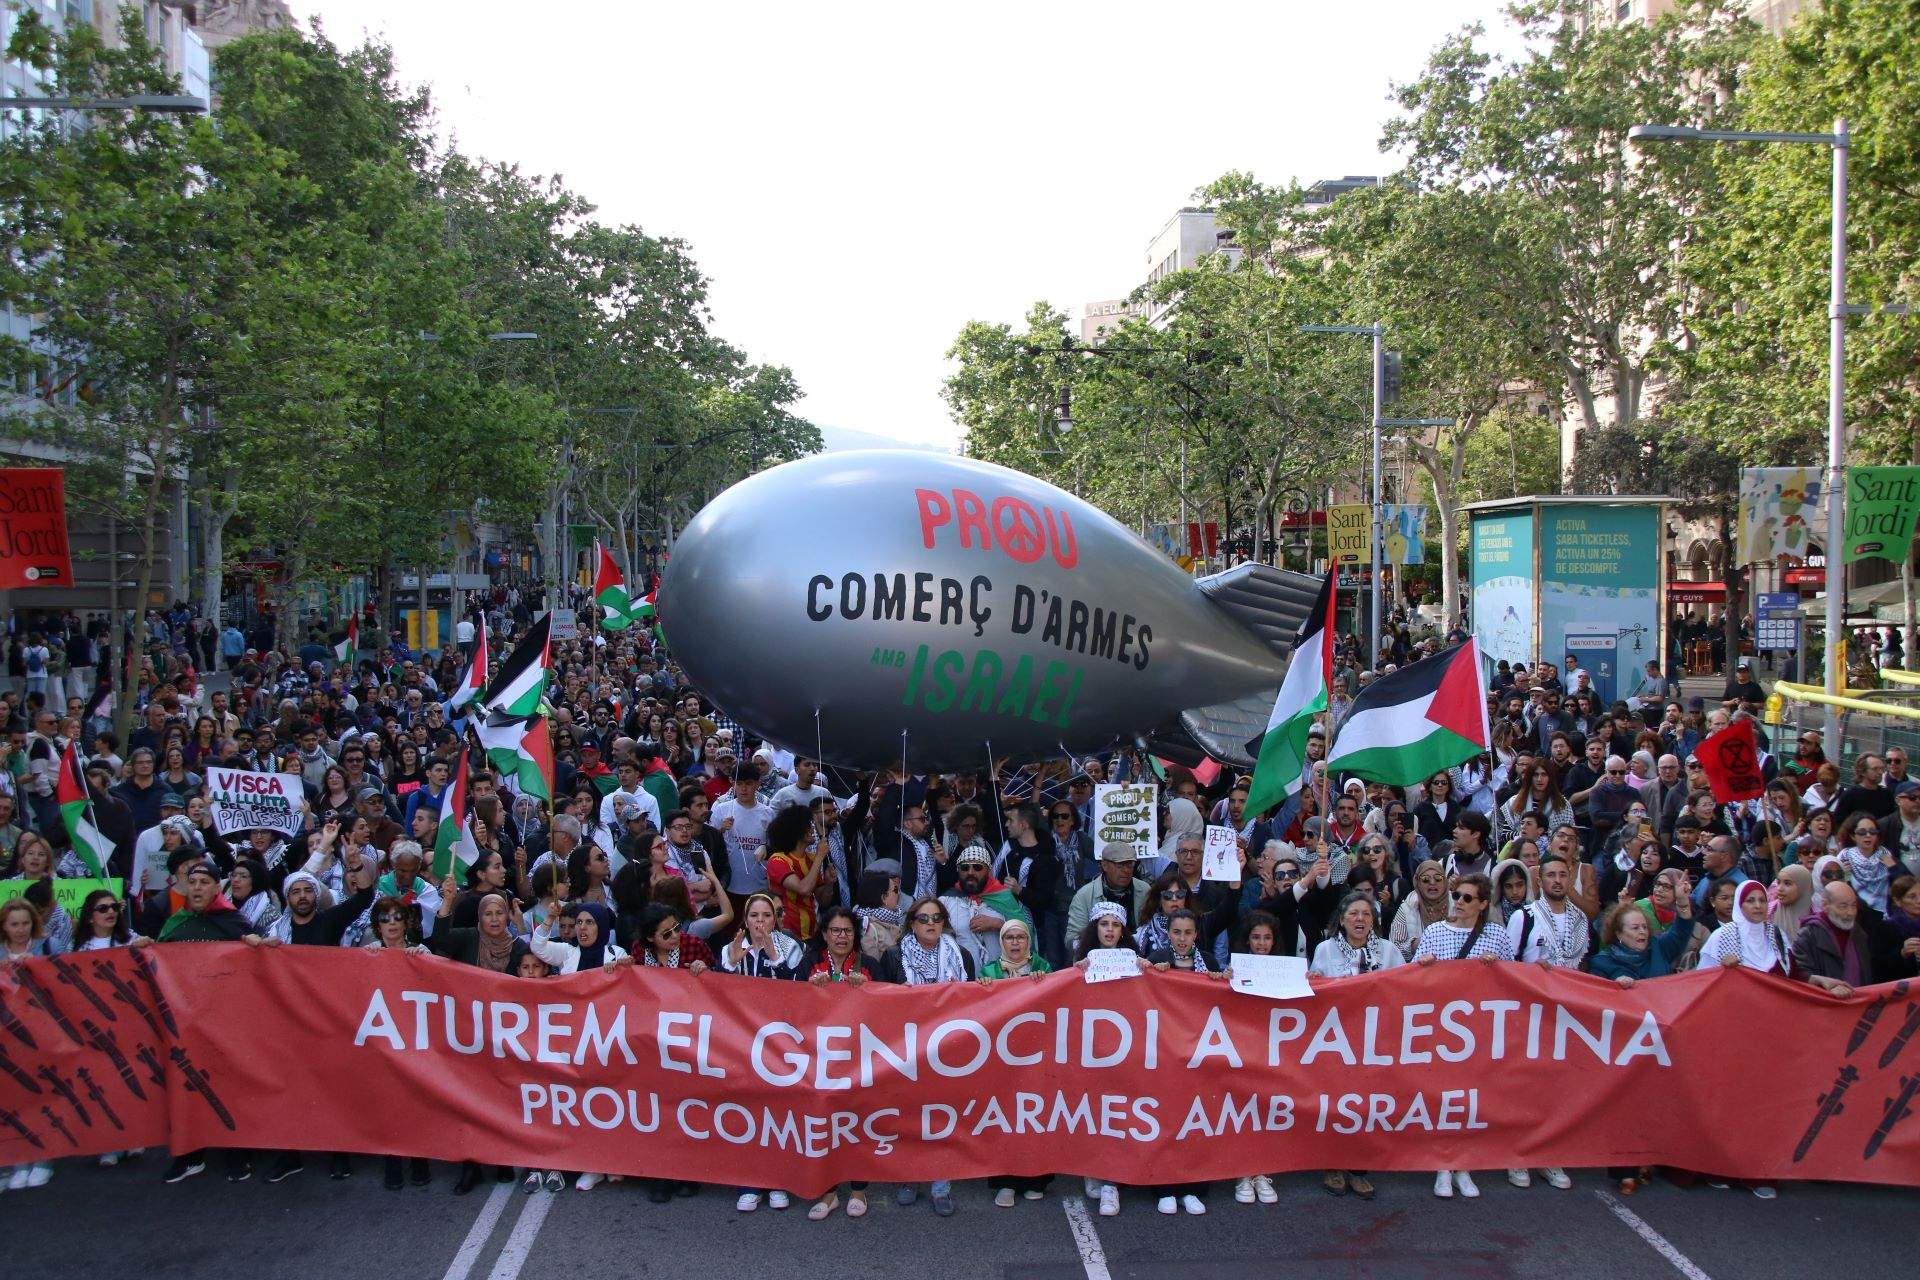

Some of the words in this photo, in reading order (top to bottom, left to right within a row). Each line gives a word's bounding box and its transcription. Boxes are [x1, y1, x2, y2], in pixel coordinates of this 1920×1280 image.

[0, 476, 57, 513] Sant
[1852, 473, 1917, 503] Sant
[1331, 508, 1367, 528] Sant
[1556, 519, 1586, 531] ACTIVA
[1846, 504, 1908, 540] Jordi
[0, 518, 66, 558] Jordi
[913, 488, 1079, 570] PROU
[1330, 530, 1367, 550] Jordi
[1555, 534, 1578, 545] SABA
[1556, 548, 1586, 560] ACTIVA
[1587, 548, 1600, 559] UN
[1601, 548, 1621, 560] 25%
[1808, 555, 1826, 567] GUY
[1556, 562, 1567, 574] DE
[1682, 594, 1704, 602] GUYS
[1758, 596, 1769, 609] P
[806, 572, 993, 637] COMERÇ
[1011, 584, 1153, 671] D'ARMES
[870, 647, 906, 668] AMB
[902, 644, 1085, 729] ISRAEL
[218, 772, 284, 795] VISCA
[213, 790, 231, 803] LA
[235, 793, 292, 810] LLUITA
[220, 801, 245, 811] DEL
[1110, 792, 1138, 805] PROU
[354, 988, 638, 1067] ATUREM
[658, 1011, 726, 1079] EL
[750, 1007, 1159, 1090] GENOCIDI
[1187, 1006, 1243, 1069] A
[1267, 1000, 1673, 1067] PALESTINA
[520, 1083, 661, 1133] PROU
[676, 1098, 900, 1158] COMERÇ
[921, 1089, 1161, 1142] D'ARMES
[1176, 1092, 1295, 1141] AMB
[1315, 1088, 1488, 1134] ISRAEL
